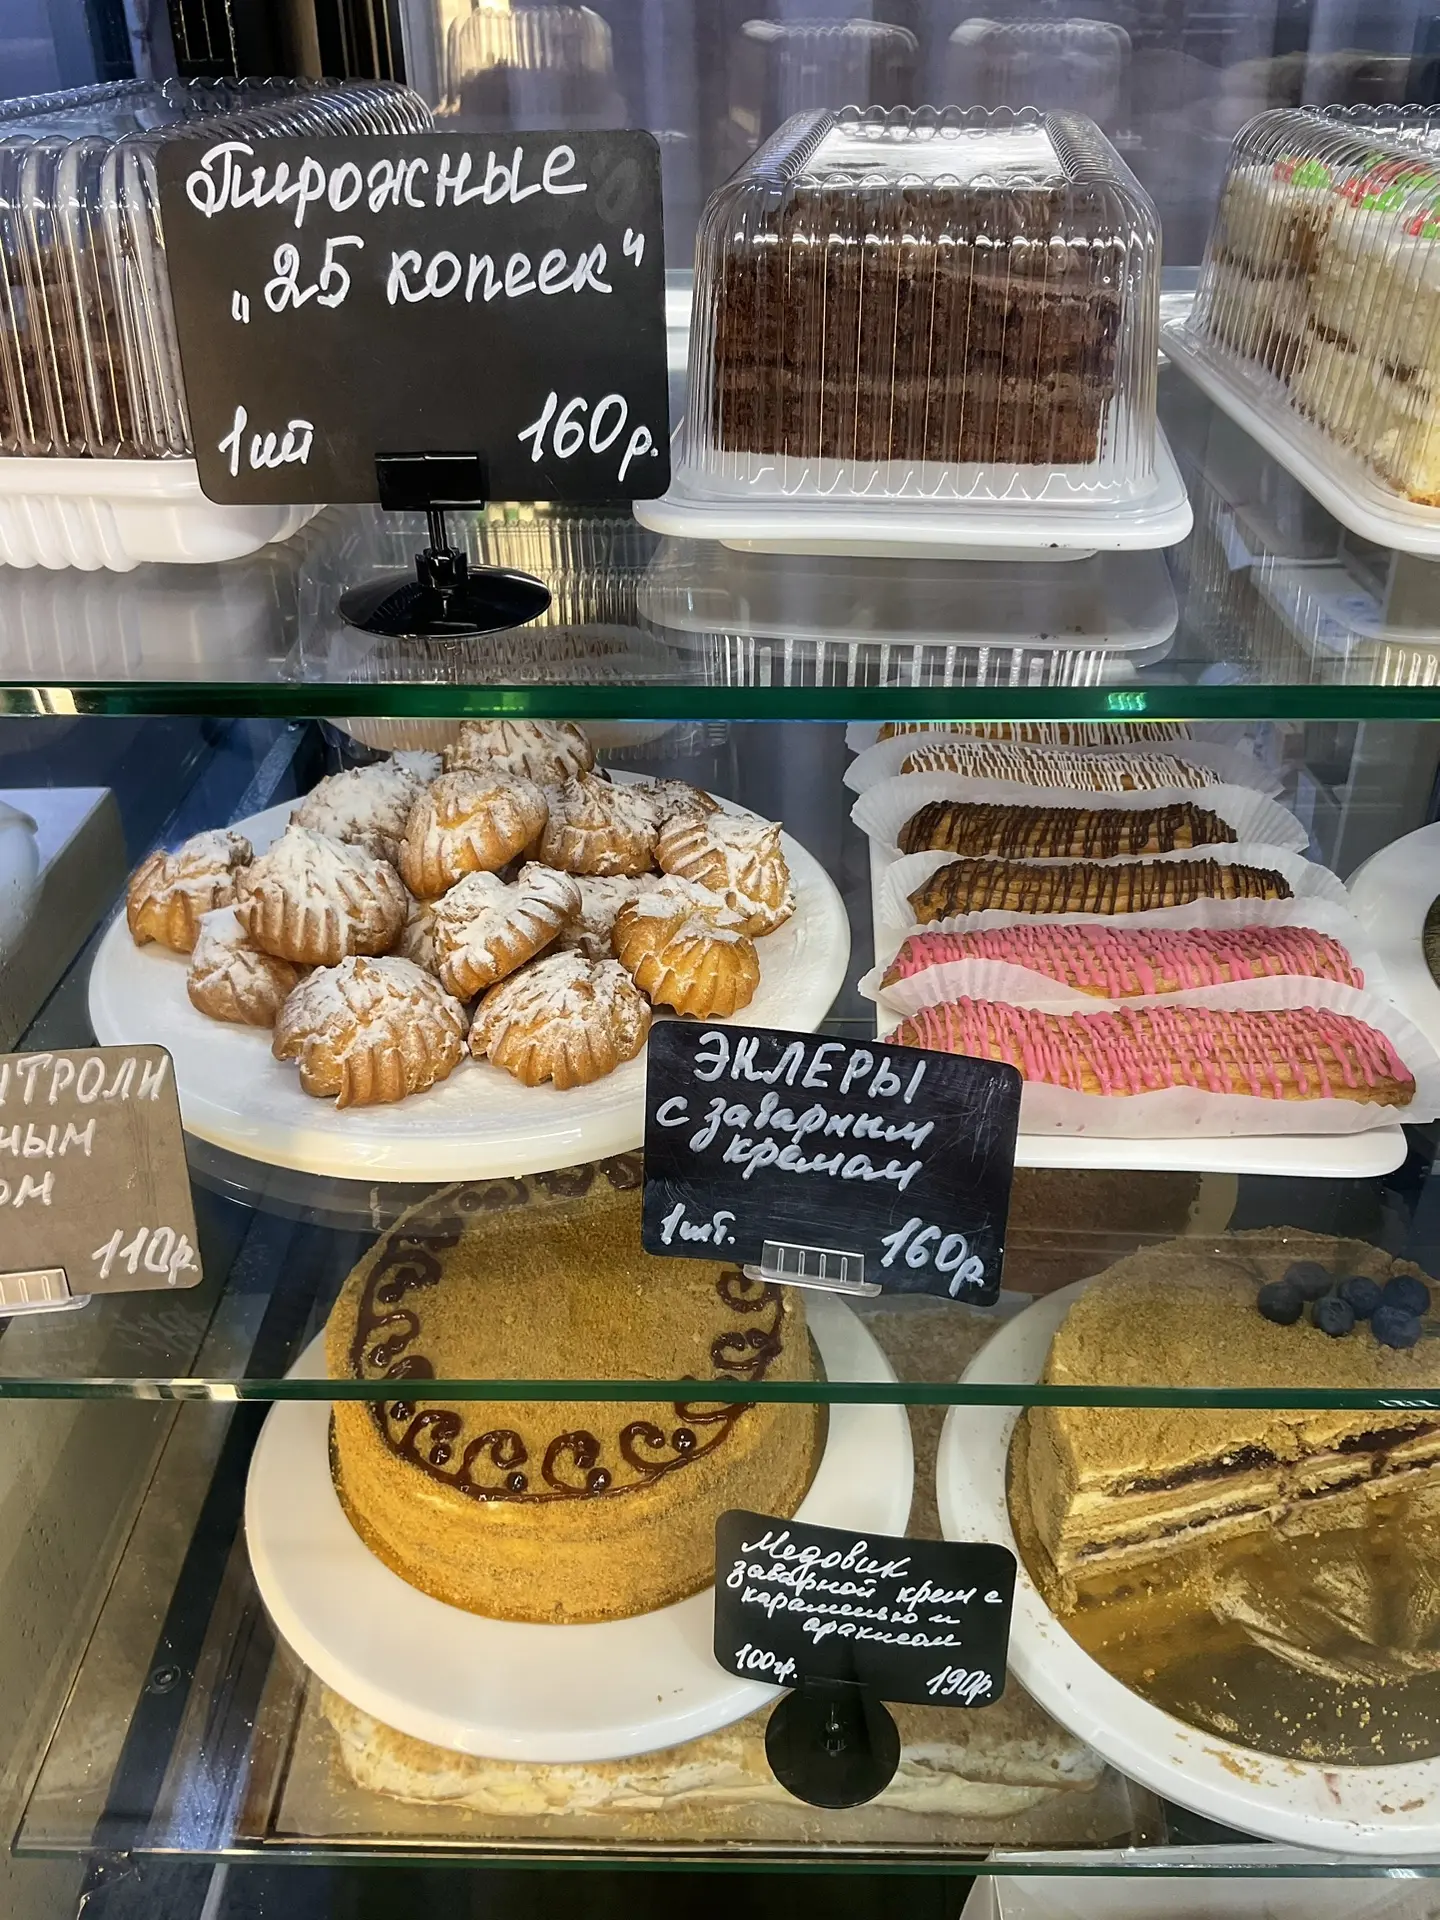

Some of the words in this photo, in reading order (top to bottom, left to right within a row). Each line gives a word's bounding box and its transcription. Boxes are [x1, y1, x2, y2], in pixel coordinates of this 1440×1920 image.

[186, 141, 588, 228] Пирожные
[693, 1030, 927, 1105] ЭКЛЕРЫ
[689, 1091, 935, 1152] заварным
[740, 1530, 912, 1580] Медовик
[726, 1560, 878, 1598] заварной
[896, 1580, 977, 1612] крем
[741, 1585, 919, 1625] карамелью
[802, 1616, 962, 1646] арахисом
